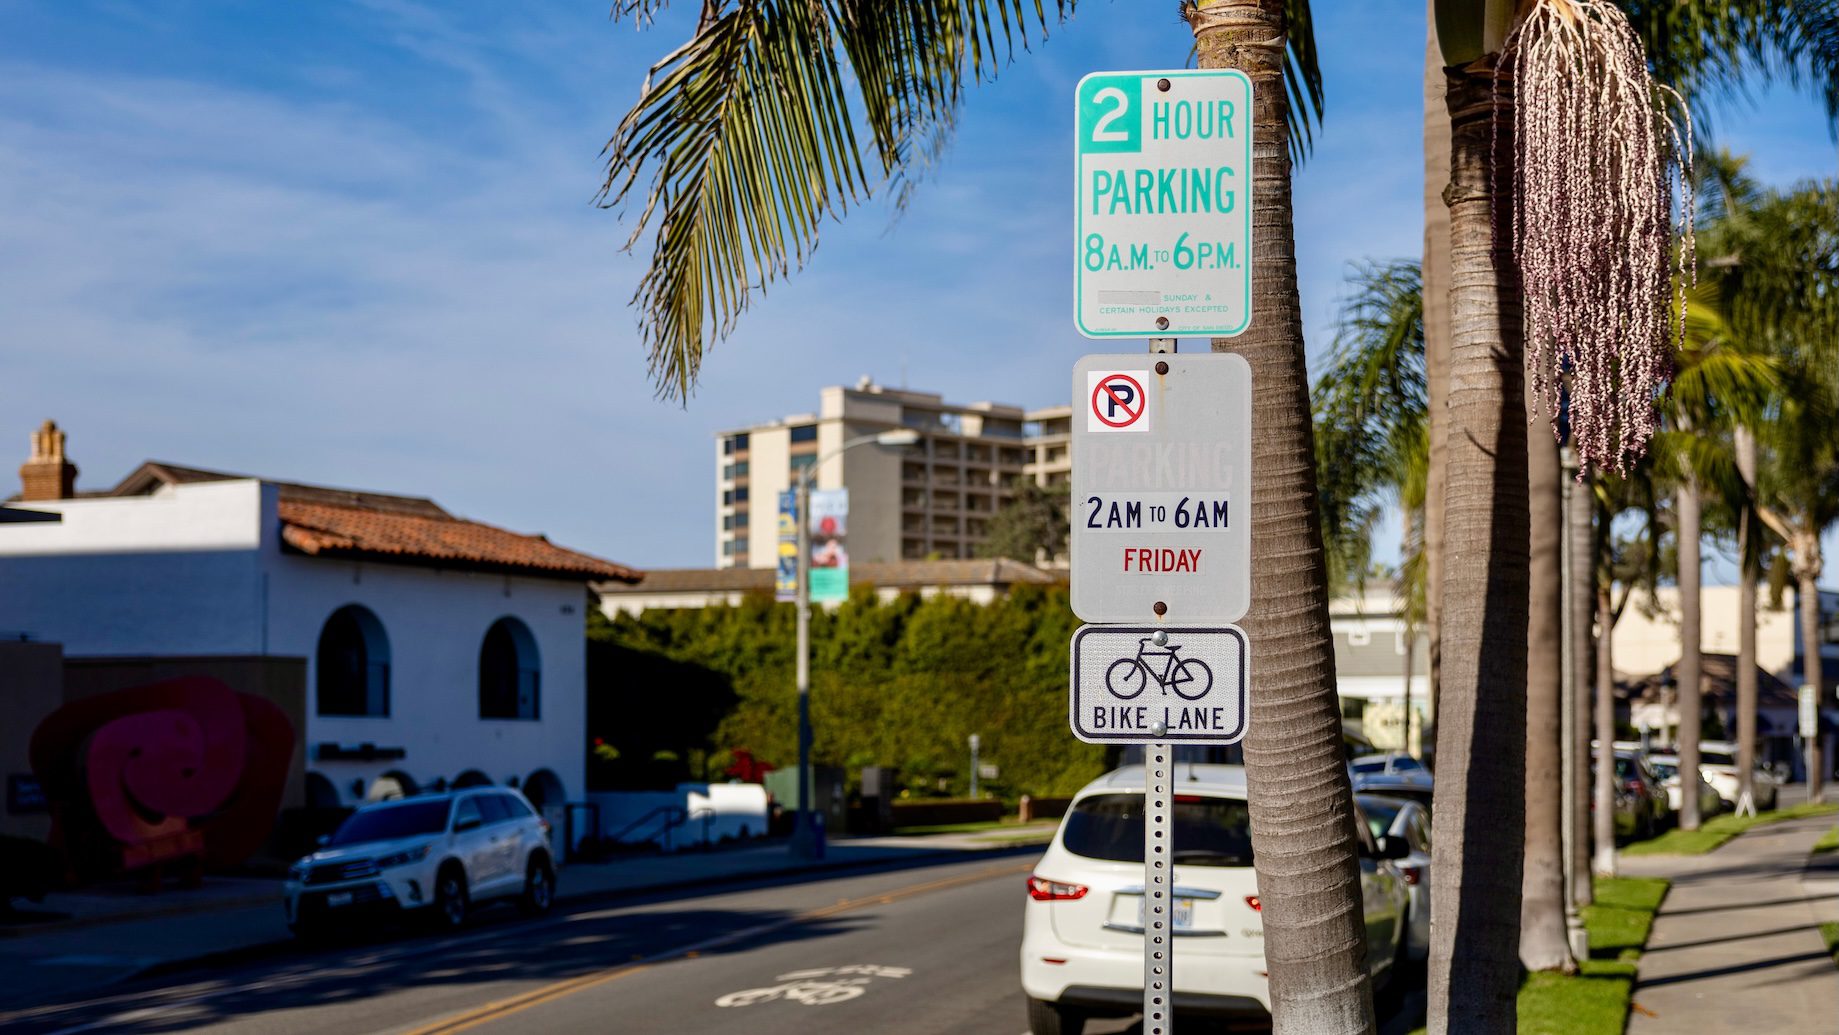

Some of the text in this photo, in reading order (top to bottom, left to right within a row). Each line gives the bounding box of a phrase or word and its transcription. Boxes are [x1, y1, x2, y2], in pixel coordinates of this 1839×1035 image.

[1092, 87, 1234, 142] 2 HOUR
[1092, 167, 1235, 216] PARKING
[1154, 250, 1169, 263] TO
[1099, 305, 1229, 314] CERTAIN HOLIDAYS EXCEPTED
[1163, 294, 1198, 302] SUNDAY
[1087, 496, 1229, 529] 2AM TO 6AM
[1124, 548, 1202, 573] FRIDAY
[1094, 706, 1224, 730] BIKE LANE
